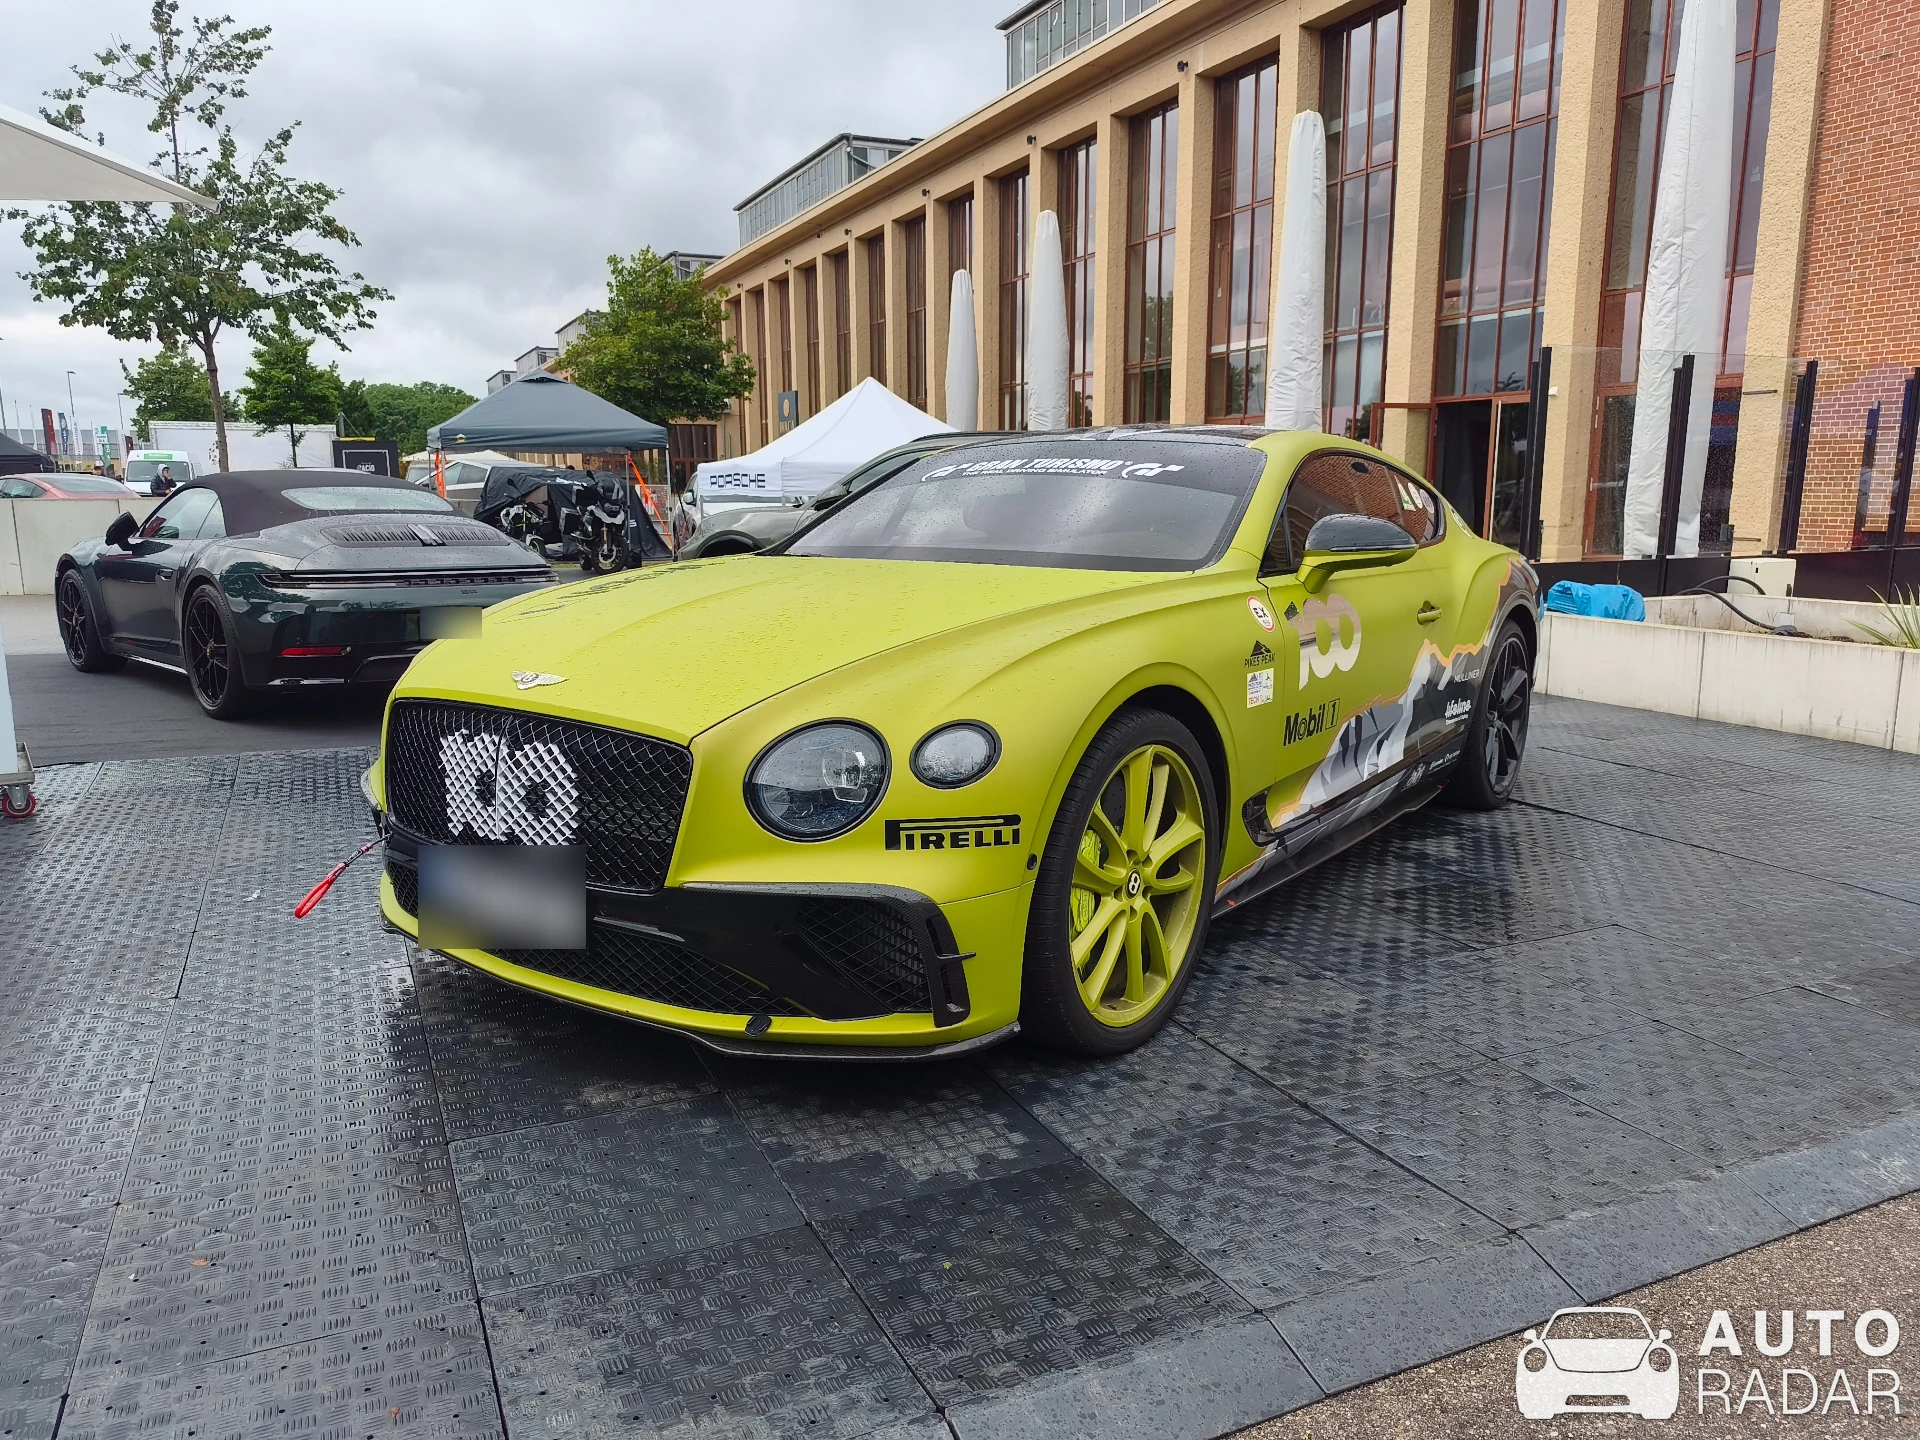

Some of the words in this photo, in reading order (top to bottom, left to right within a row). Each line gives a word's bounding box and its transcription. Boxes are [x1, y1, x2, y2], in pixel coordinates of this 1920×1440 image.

[965, 458, 1029, 472] GRAN
[1026, 458, 1125, 471] TURISMO
[1046, 468, 1108, 476] SIMULATOR
[710, 473, 766, 488] PORSCHE
[1253, 606, 1269, 618] EX
[1244, 656, 1260, 668] PIKES
[1261, 653, 1276, 665] PEAK
[1453, 669, 1480, 683] MULLINER
[1283, 703, 1326, 746] Mobil
[885, 814, 1021, 850] PIRELLI
